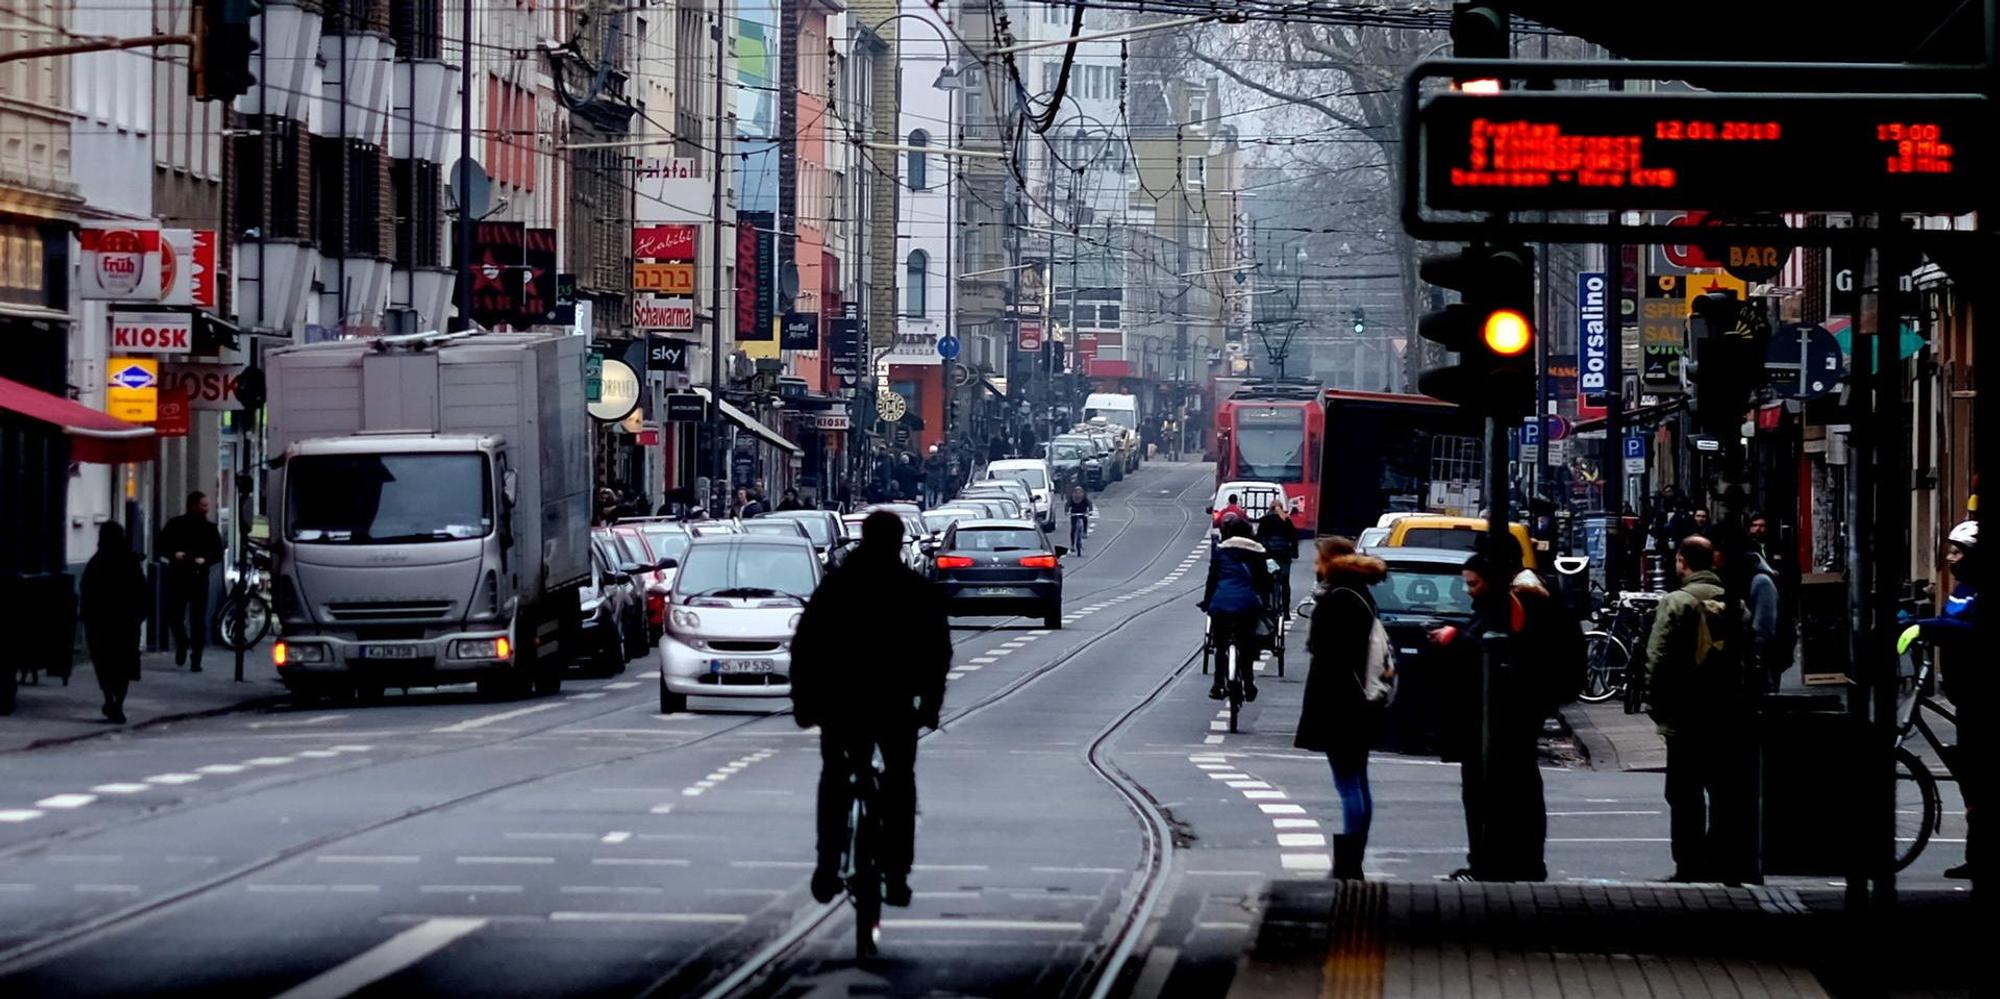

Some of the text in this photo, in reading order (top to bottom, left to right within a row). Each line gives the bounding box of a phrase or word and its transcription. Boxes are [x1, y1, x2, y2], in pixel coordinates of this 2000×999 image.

[1877, 123, 1940, 140] 15:00
[1917, 142, 1952, 157] Min
[1916, 157, 1951, 172] Min
[634, 230, 693, 256] Habibi
[103, 256, 135, 273] früh
[1729, 245, 1778, 268] BAR
[635, 270, 691, 287] ברכה
[634, 301, 691, 328] Schawarma
[115, 327, 188, 348] KIOSK
[1581, 276, 1605, 389] Borsalino
[651, 345, 681, 364] sky
[816, 416, 847, 427] KIOSK
[1628, 439, 1641, 455] P
